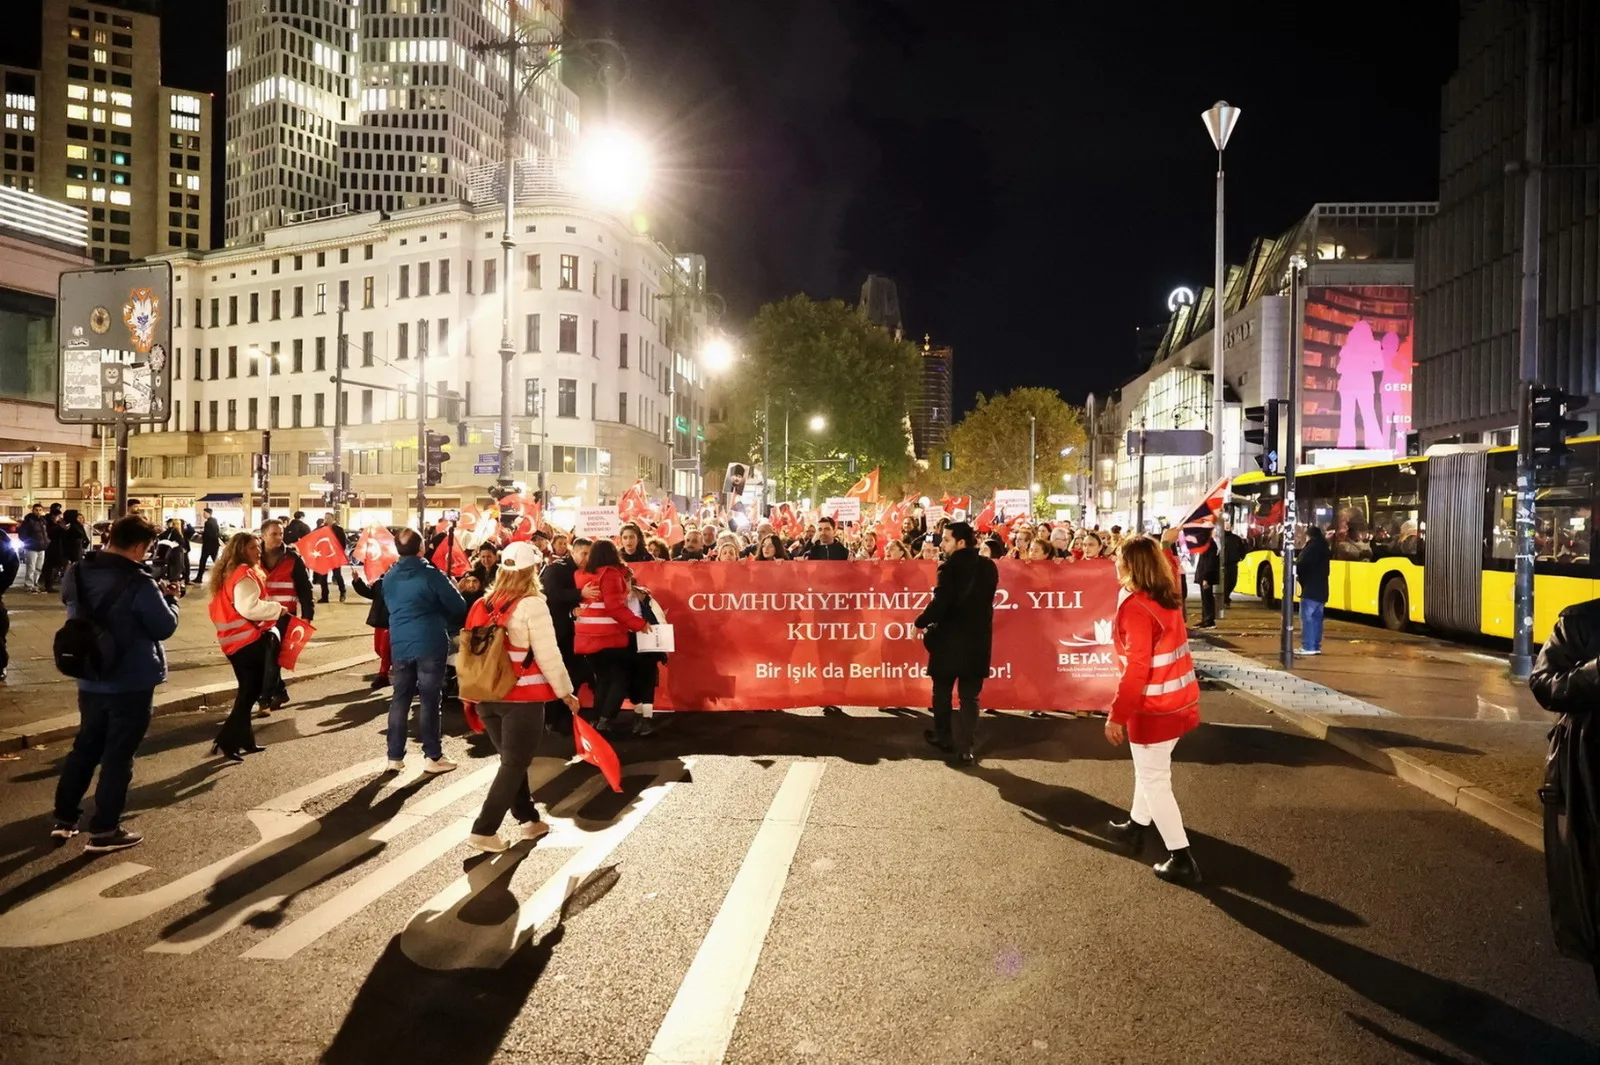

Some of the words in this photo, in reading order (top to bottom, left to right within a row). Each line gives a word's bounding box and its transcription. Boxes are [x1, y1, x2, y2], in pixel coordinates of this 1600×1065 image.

[992, 589, 1019, 610] 2.
[1026, 590, 1083, 609] YILI
[787, 622, 877, 641] KUTLU
[1058, 652, 1113, 665] BETAK
[755, 662, 782, 678] Bir
[787, 662, 817, 684] Işık
[822, 662, 844, 678] da
